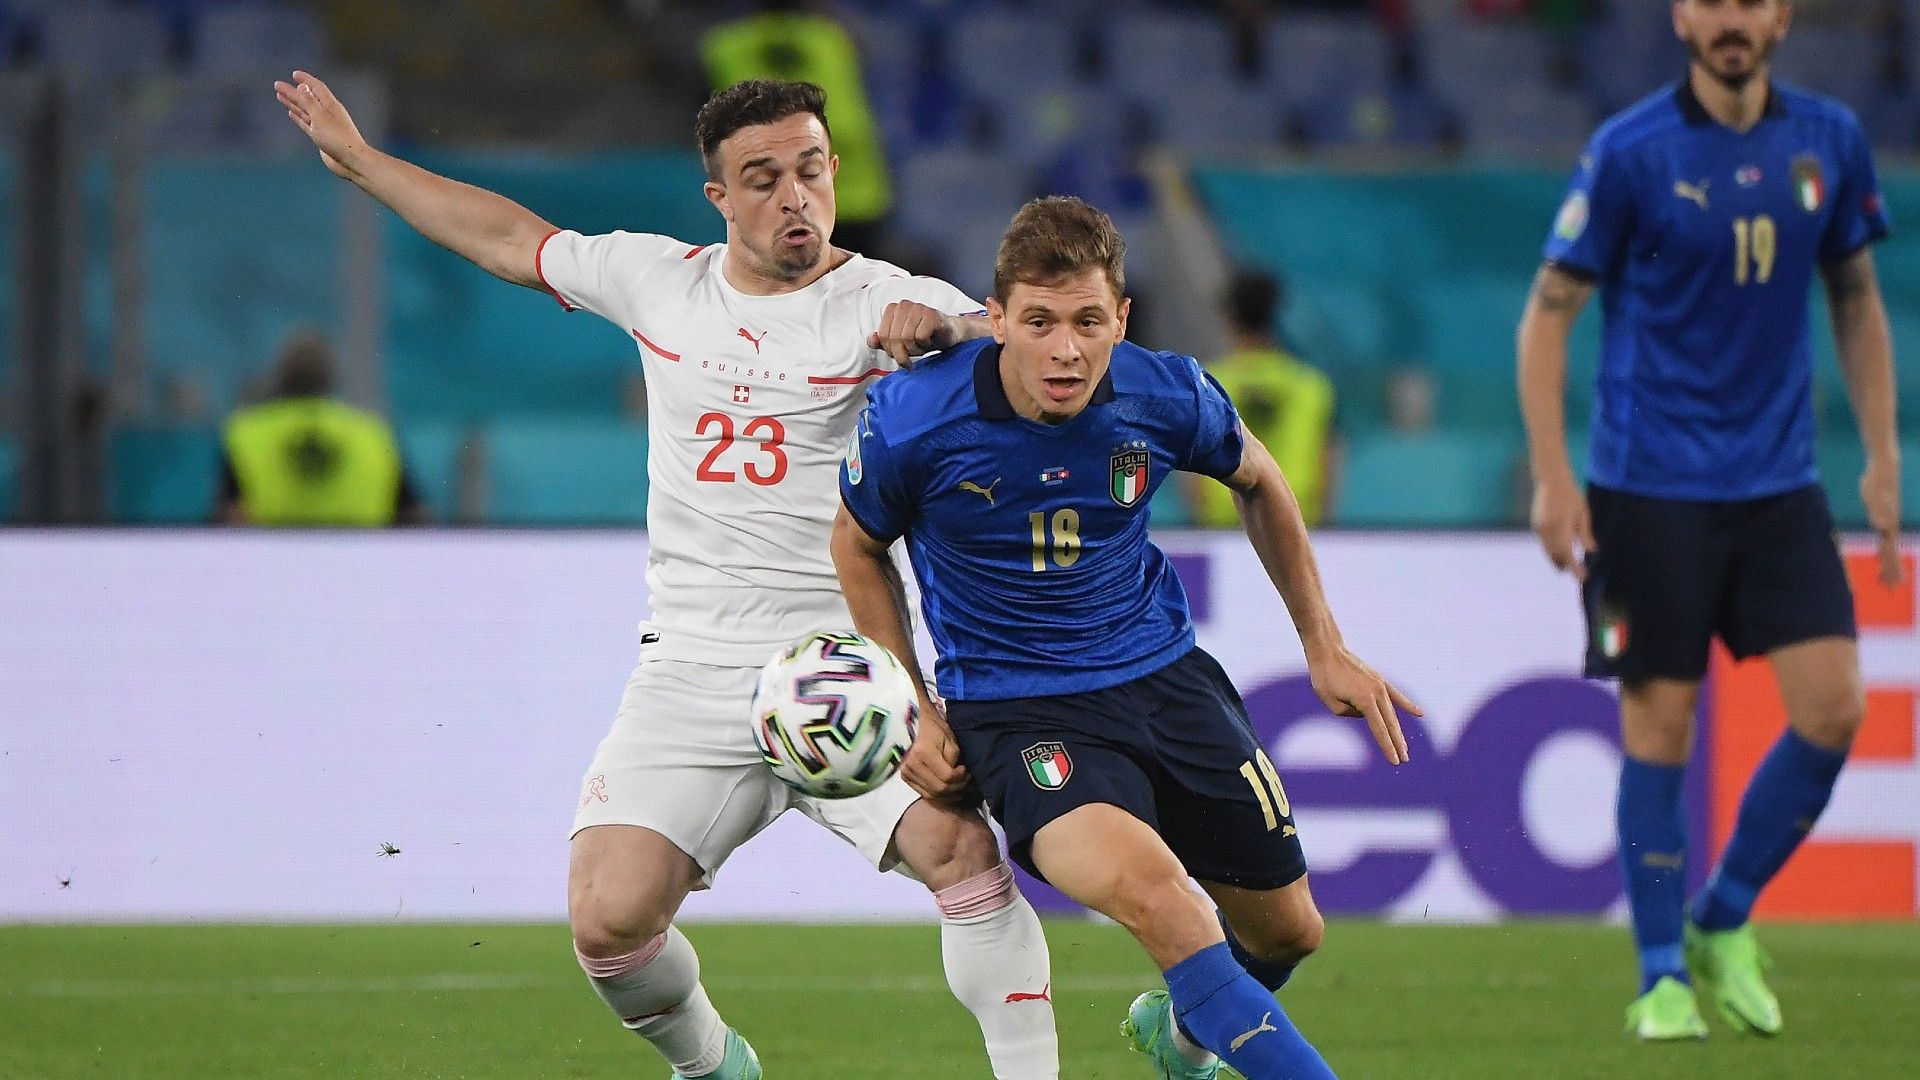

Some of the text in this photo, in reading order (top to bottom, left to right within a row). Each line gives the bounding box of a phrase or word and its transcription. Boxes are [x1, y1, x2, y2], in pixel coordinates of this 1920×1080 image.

[1733, 214, 1776, 286] 19
[702, 359, 785, 381] suisse
[694, 412, 789, 486] 23
[1114, 454, 1146, 467] ITALIA
[1029, 508, 1081, 572] 18
[1026, 745, 1061, 759] ITALIA
[1239, 747, 1290, 832] 18
